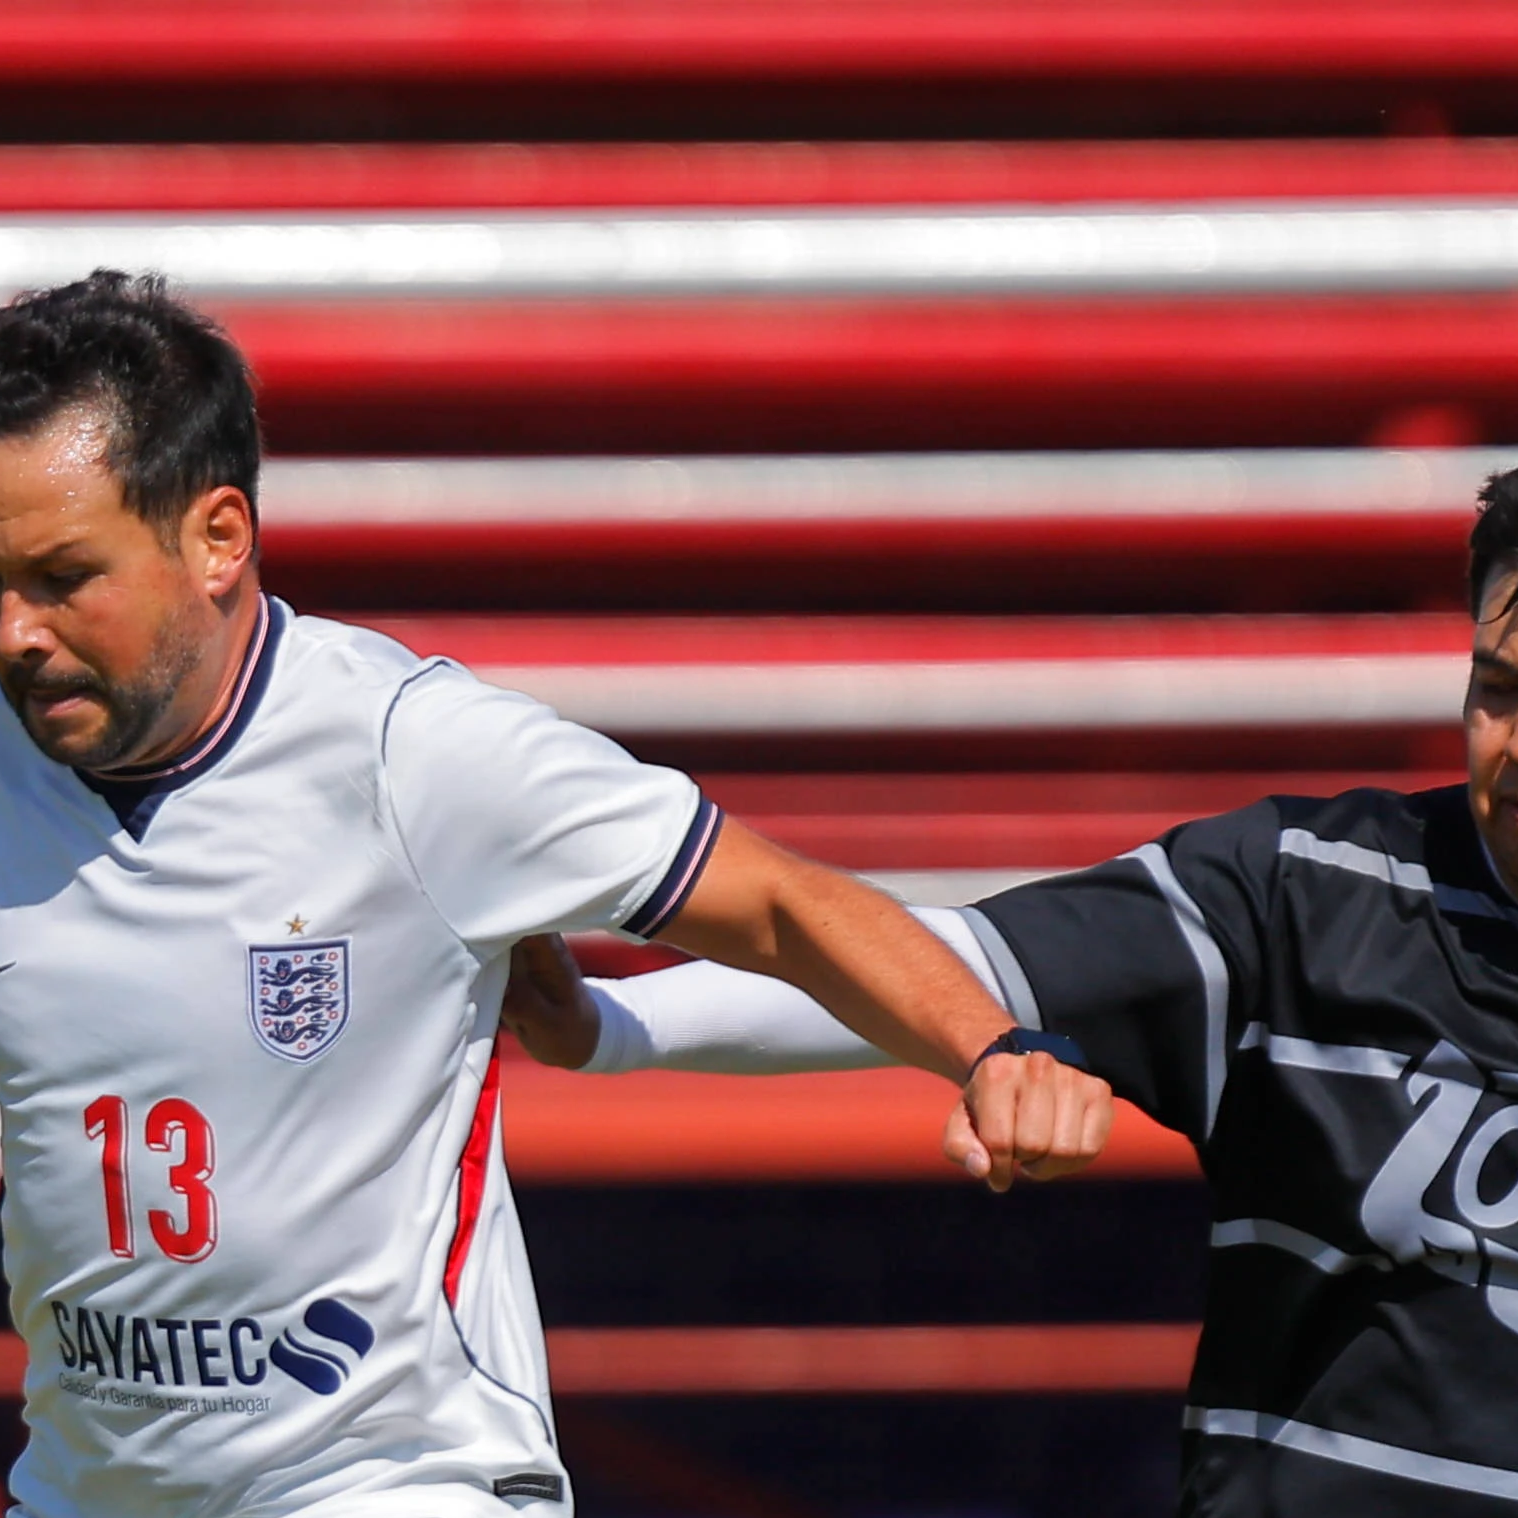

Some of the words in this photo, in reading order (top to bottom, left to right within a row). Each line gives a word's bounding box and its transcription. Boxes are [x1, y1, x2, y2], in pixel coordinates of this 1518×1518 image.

[83, 1094, 218, 1264] 13
[51, 1300, 268, 1387] SAYATEC
[201, 1396, 218, 1413] tu
[221, 1396, 272, 1416] Hogar
